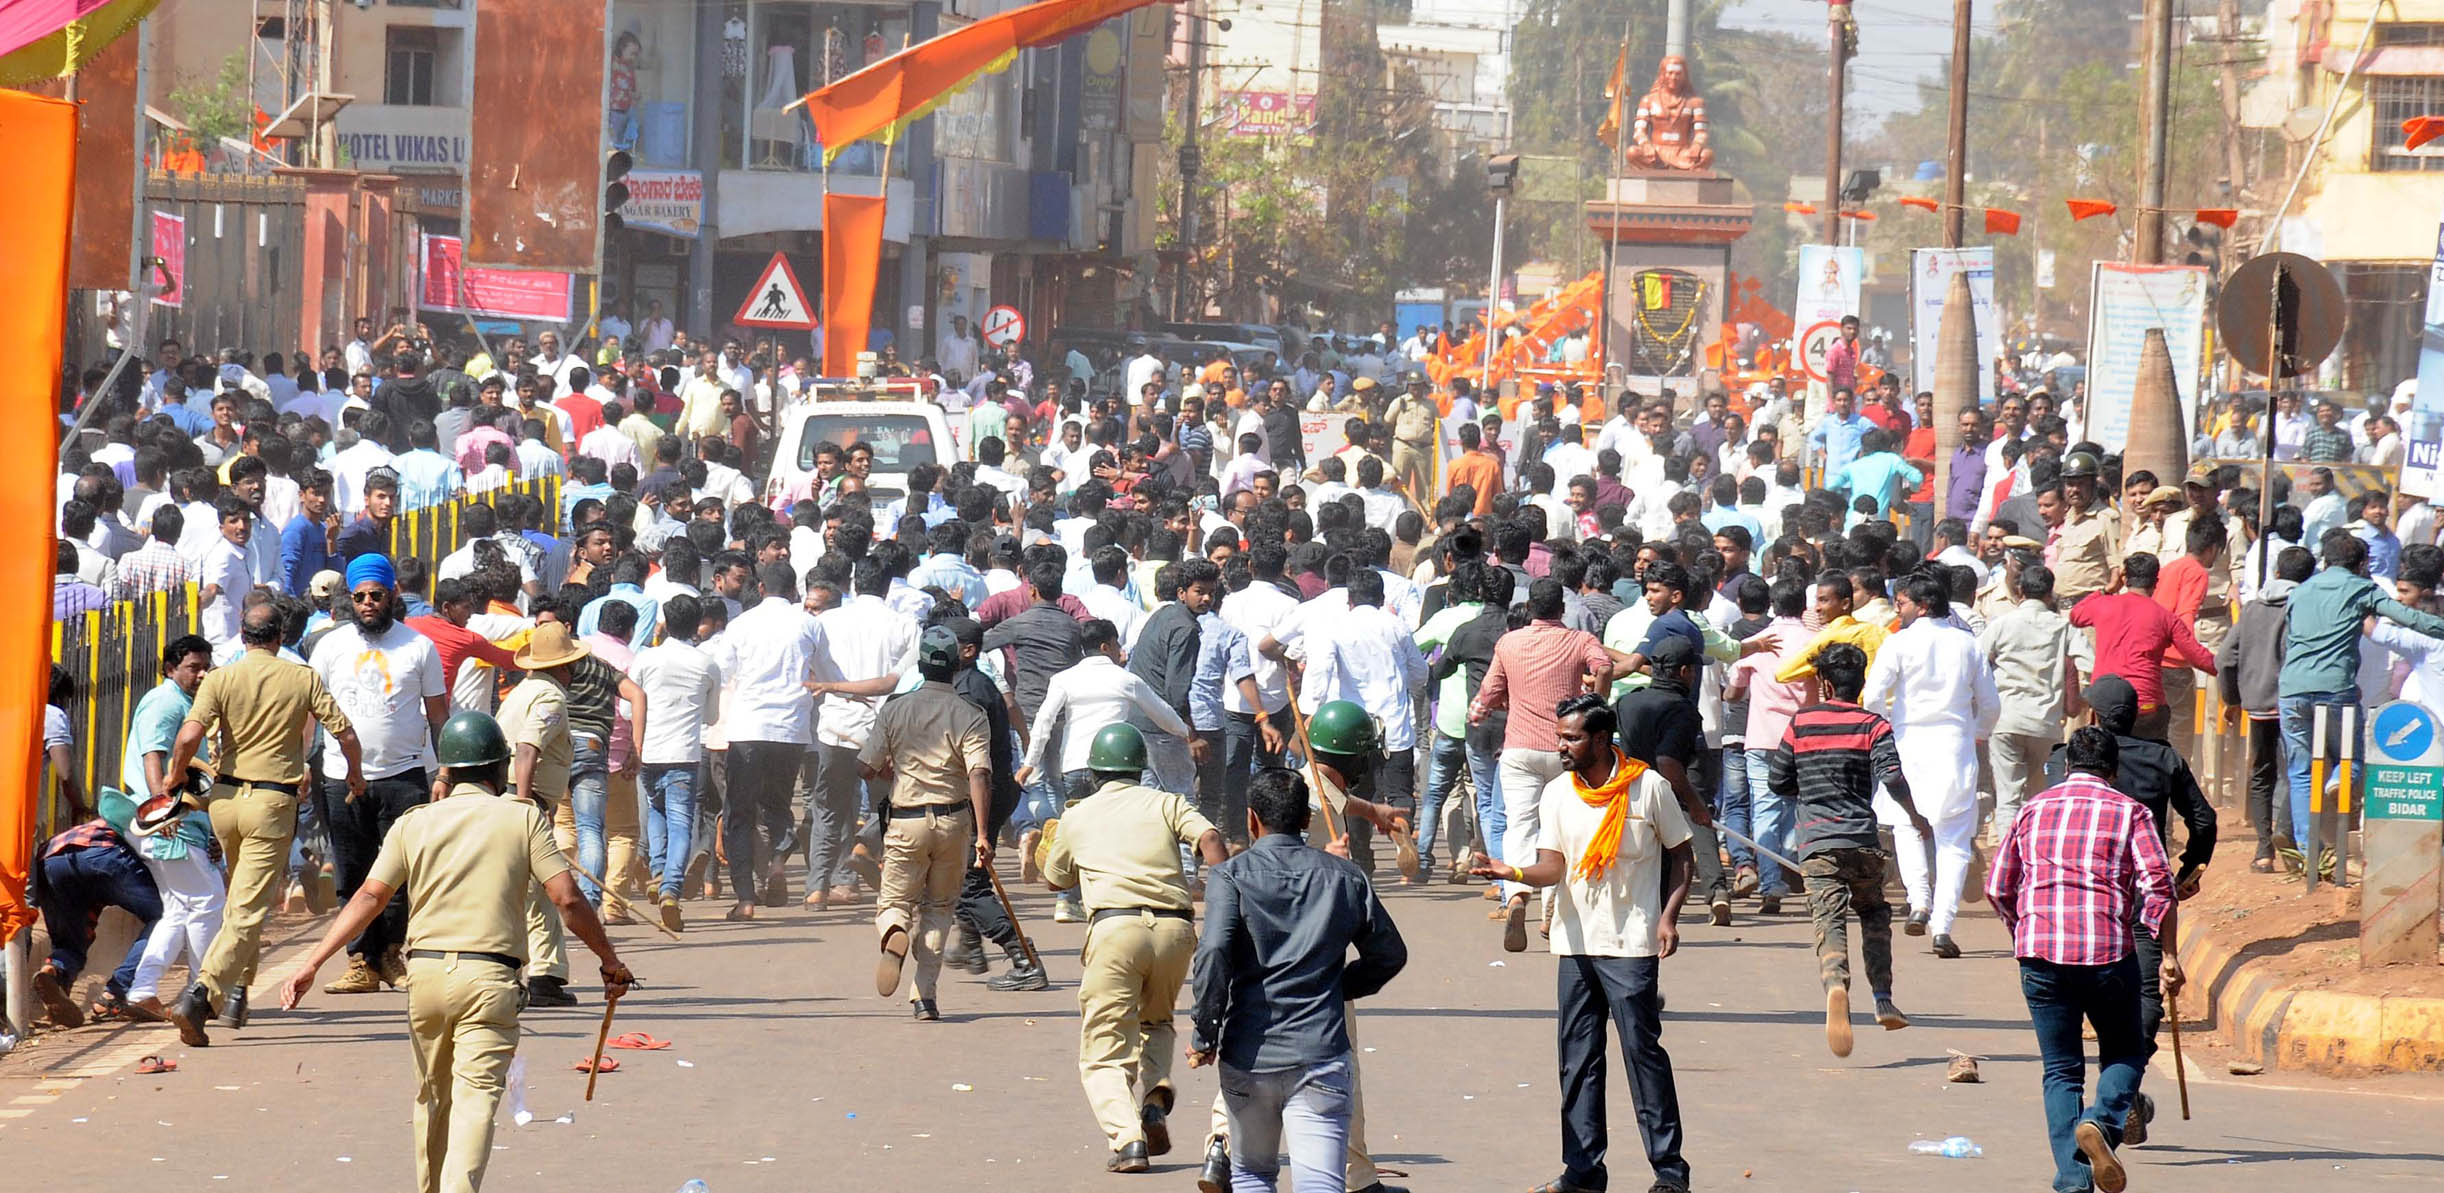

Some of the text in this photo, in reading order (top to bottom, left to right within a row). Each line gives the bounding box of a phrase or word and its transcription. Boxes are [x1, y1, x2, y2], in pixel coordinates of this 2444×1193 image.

[395, 135, 448, 162] VIKAS
[453, 136, 464, 163] L
[422, 188, 461, 208] MARKE
[620, 206, 690, 218] NGAR BAKERY
[1810, 336, 1840, 358] 4
[2412, 441, 2438, 466] Ni
[2377, 770, 2432, 785] KEEP LEFT
[2373, 787, 2437, 801] TRAFFIC POLICE
[2388, 802, 2427, 816] BIDAR
